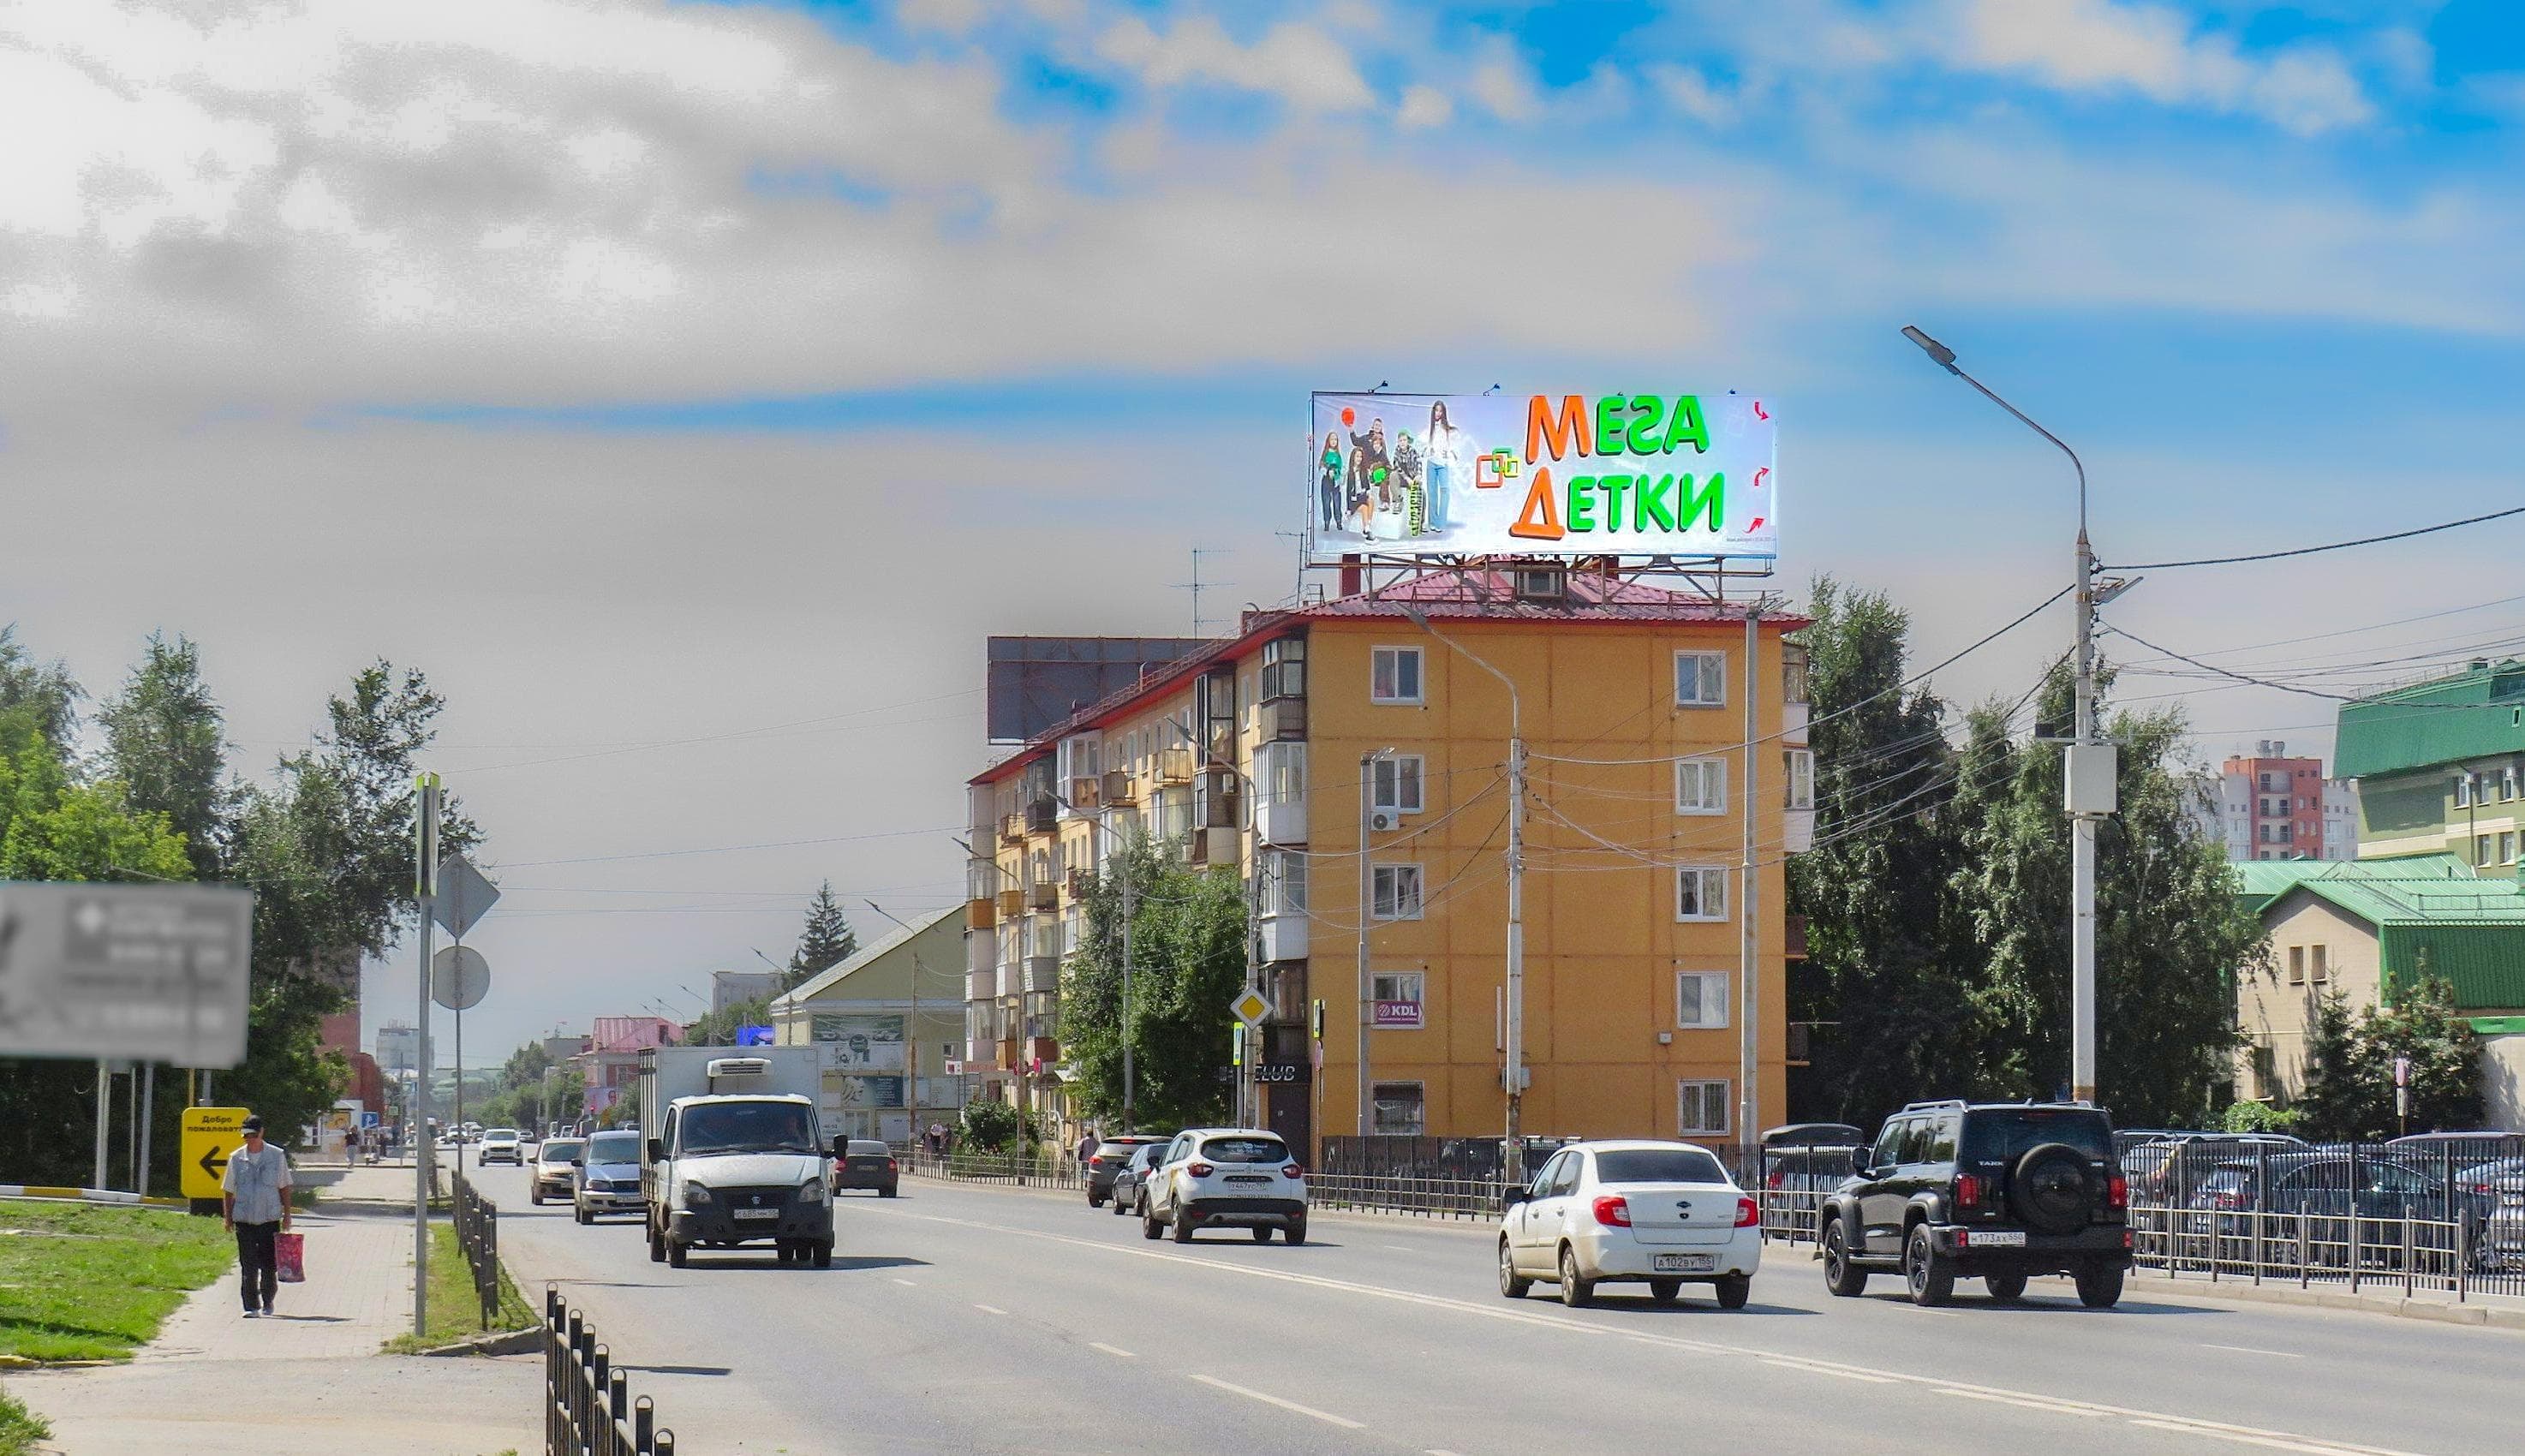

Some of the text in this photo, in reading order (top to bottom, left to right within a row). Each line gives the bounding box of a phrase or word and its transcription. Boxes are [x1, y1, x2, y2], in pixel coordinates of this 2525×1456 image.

[1508, 467, 1725, 540] ДЕТКИ
[1391, 1005, 1418, 1016] KDL
[1254, 1065, 1296, 1081] CLUB
